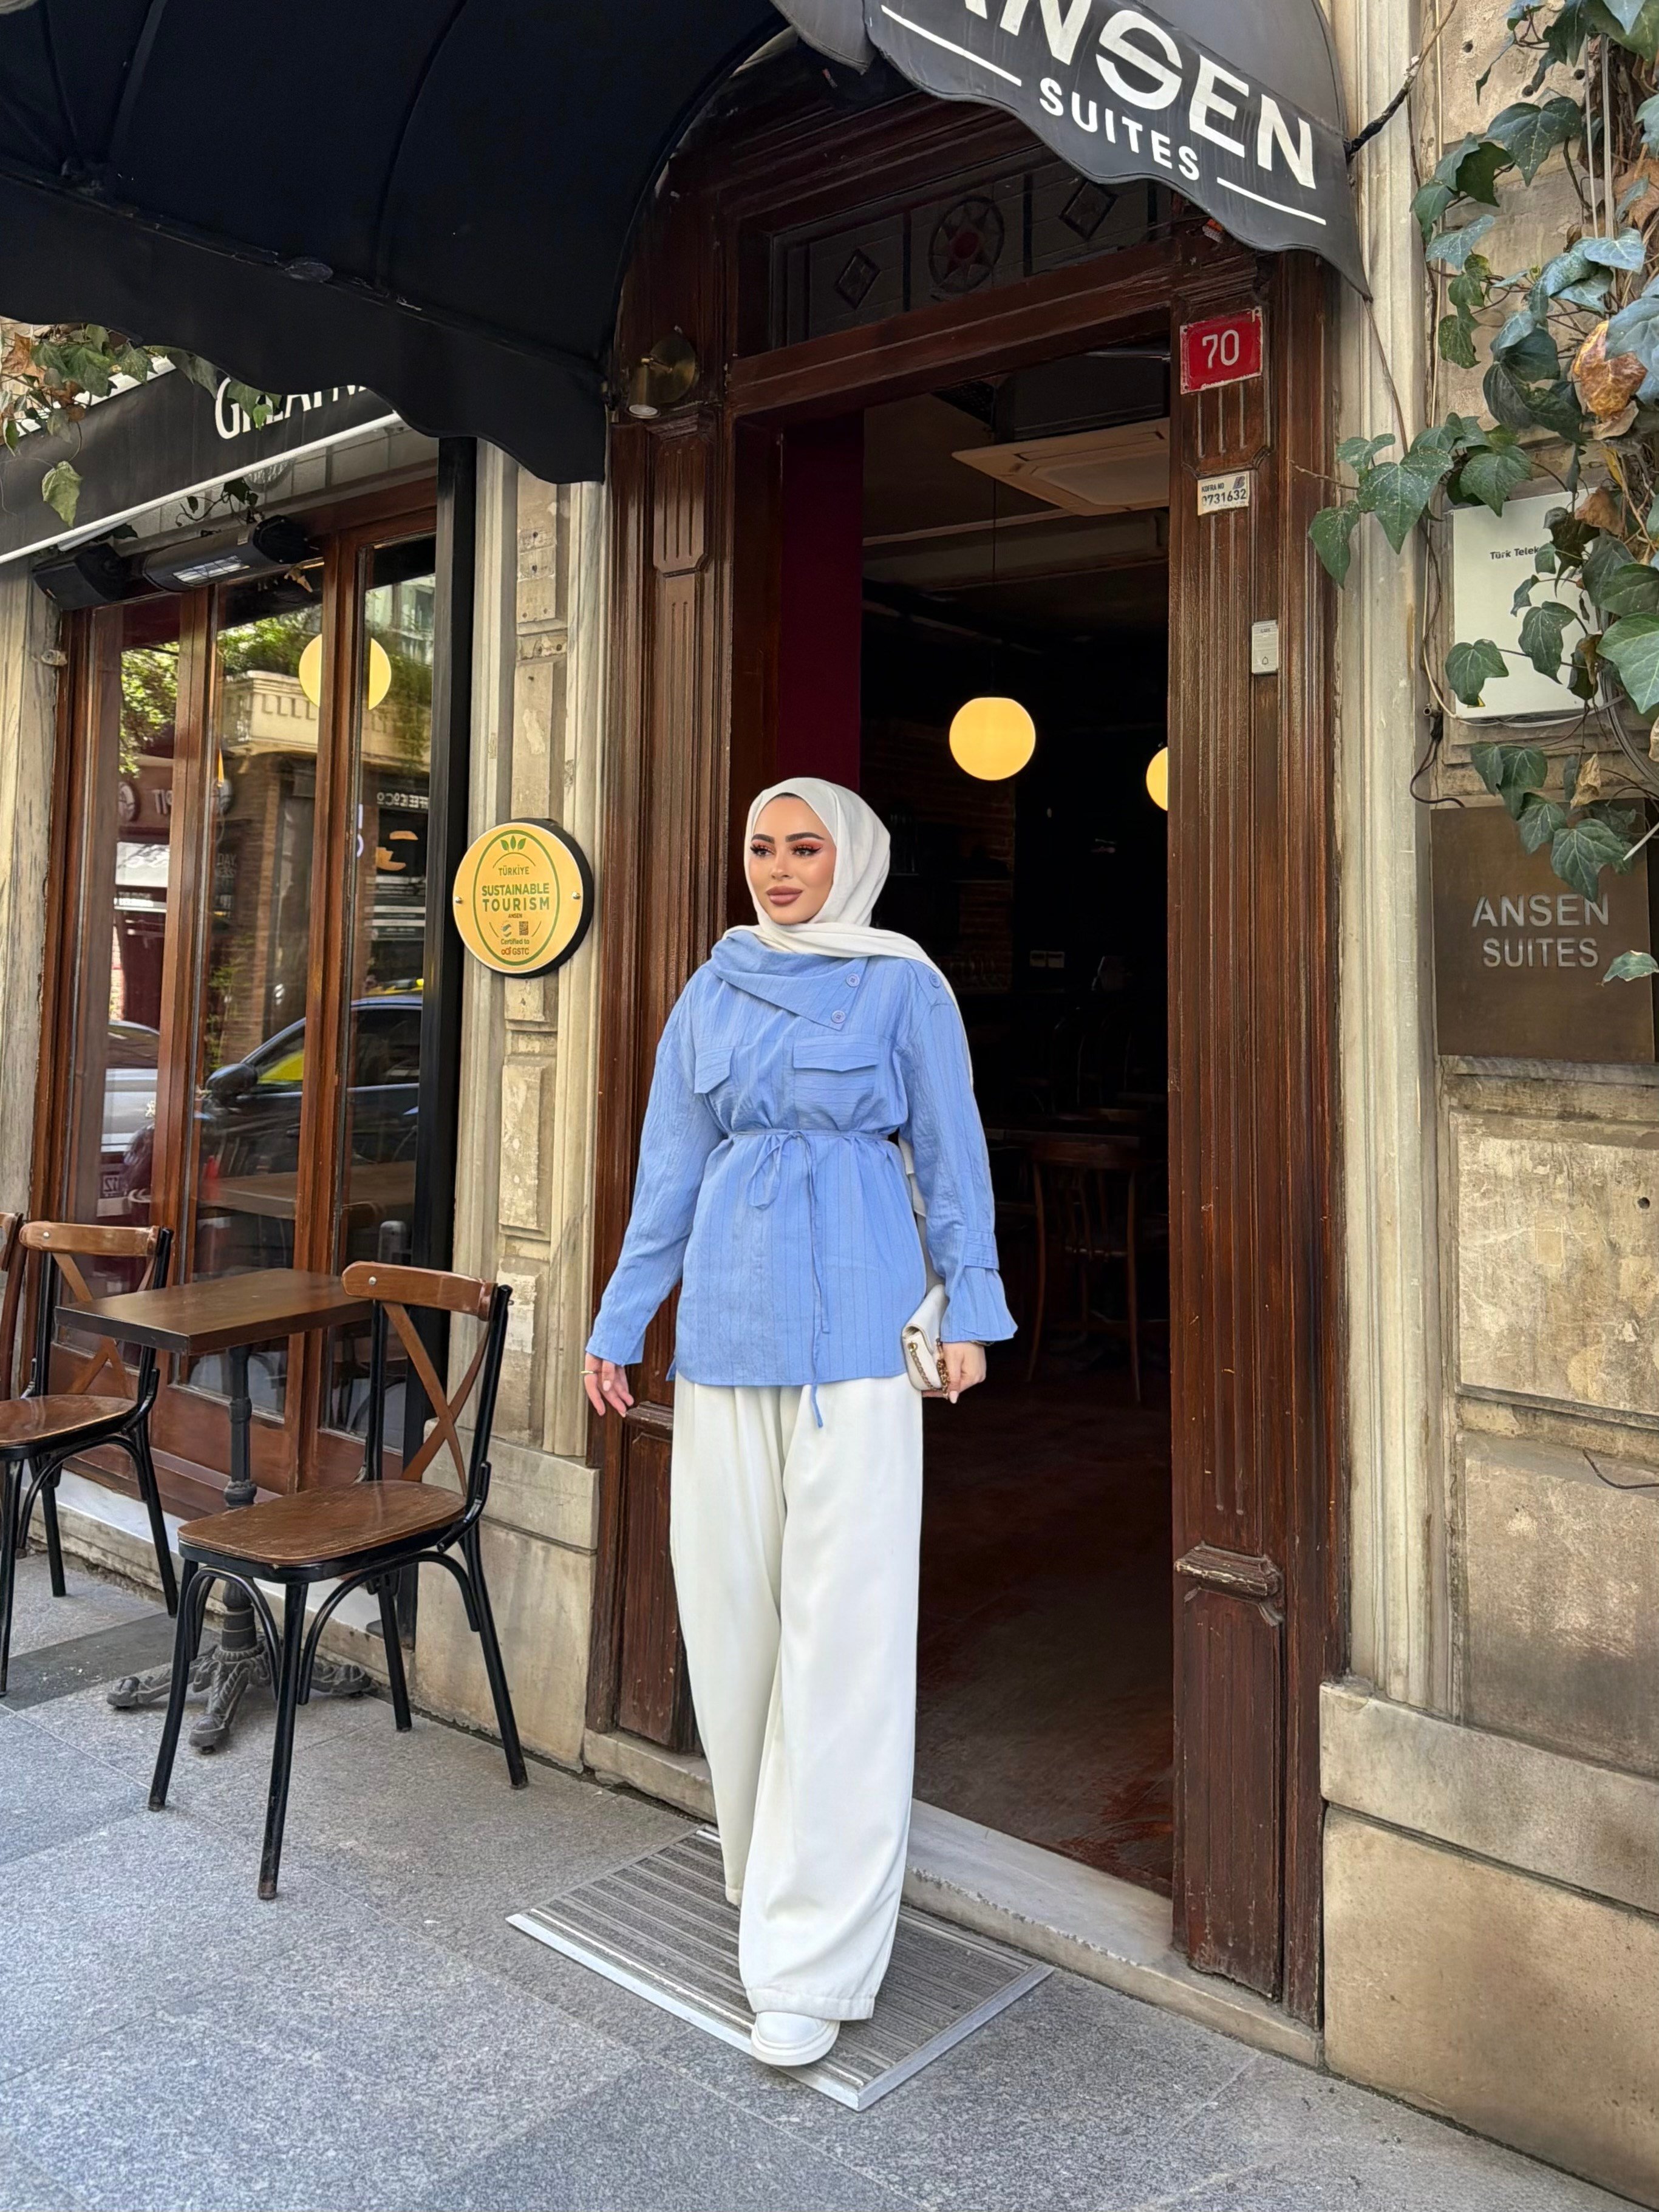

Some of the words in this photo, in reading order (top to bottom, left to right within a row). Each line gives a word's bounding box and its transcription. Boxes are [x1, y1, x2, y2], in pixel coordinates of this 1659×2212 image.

[966, 0, 1316, 189] NSEN
[1039, 77, 1199, 181] SUITES
[1202, 329, 1239, 369] 70
[1490, 550, 1511, 559] Türk
[498, 865, 530, 876] TÜRKİYE
[482, 883, 550, 896] SUSTAINABLE
[482, 897, 550, 911] TOURISM
[1471, 894, 1609, 927] ANSEN
[1483, 938, 1599, 967] SUITES
